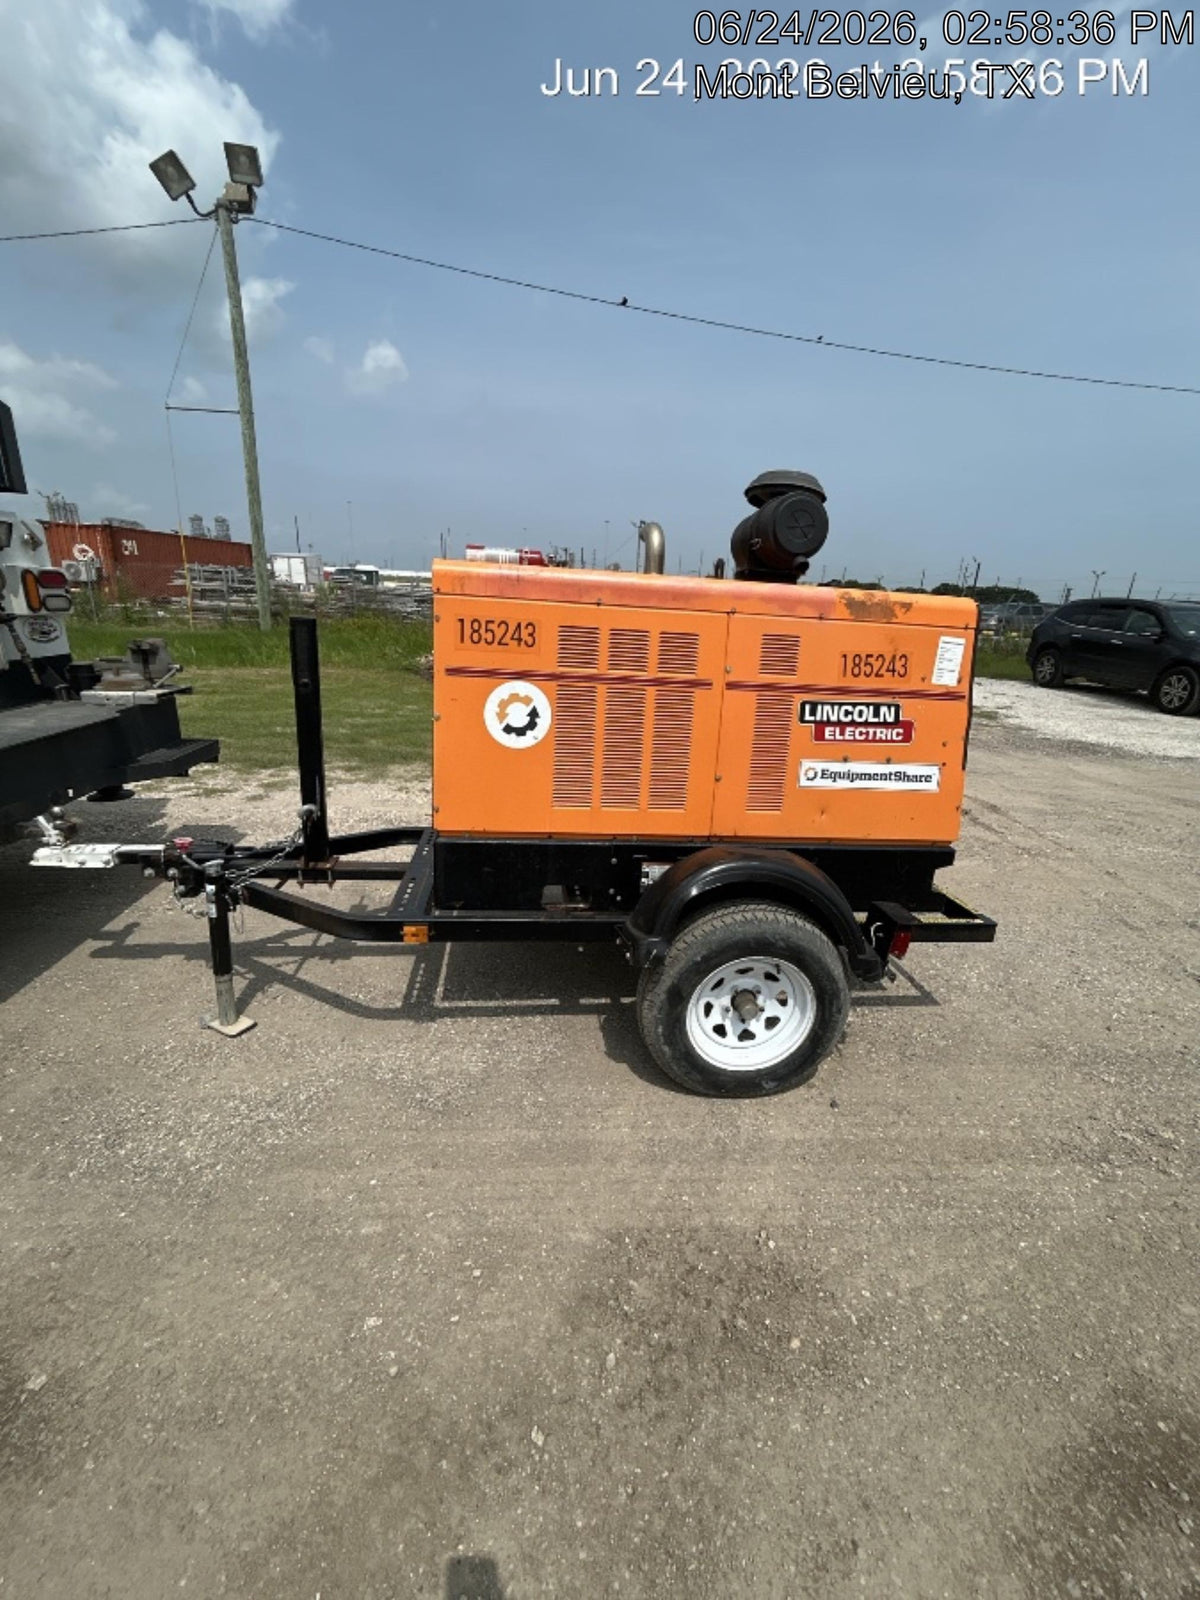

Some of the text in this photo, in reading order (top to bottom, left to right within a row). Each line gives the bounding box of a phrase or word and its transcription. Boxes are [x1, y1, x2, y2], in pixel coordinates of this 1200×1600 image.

[457, 618, 536, 648] 185243
[841, 653, 908, 678] 185243
[803, 704, 896, 723] LINCOLN
[824, 727, 904, 741] ELECTRIC
[819, 768, 933, 784] EquipmentShare
